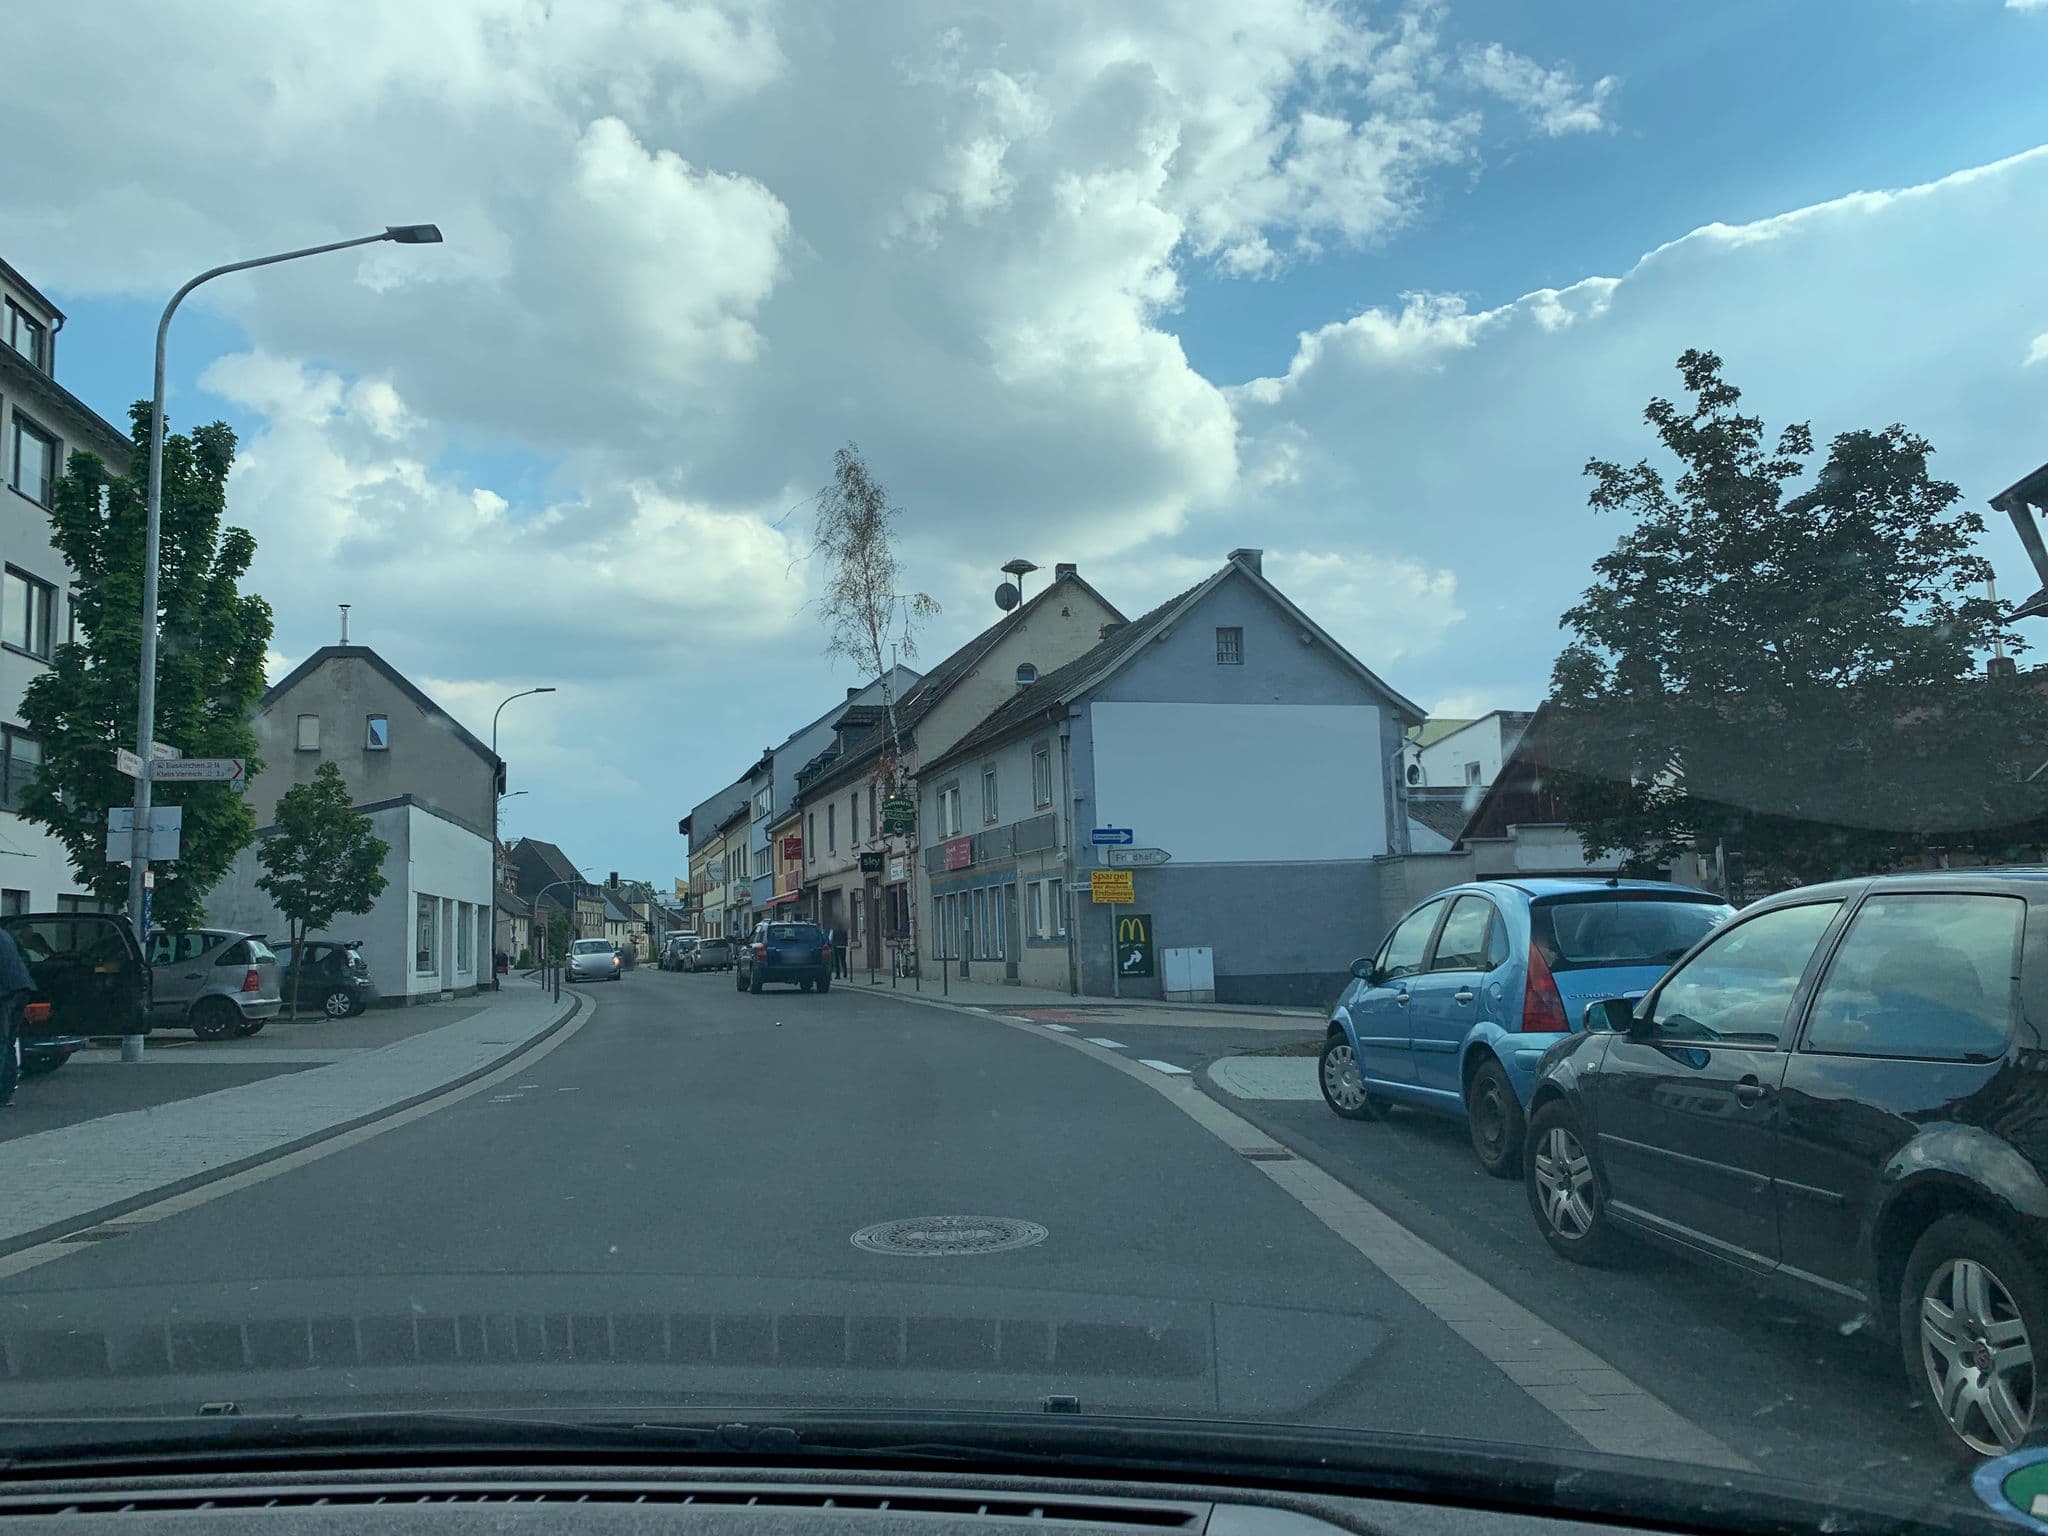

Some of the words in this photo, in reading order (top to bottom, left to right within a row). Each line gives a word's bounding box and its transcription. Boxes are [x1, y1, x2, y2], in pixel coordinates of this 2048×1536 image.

[165, 761, 205, 769] Euskirchen
[863, 857, 880, 868] sky
[1092, 871, 1128, 882] Spargel
